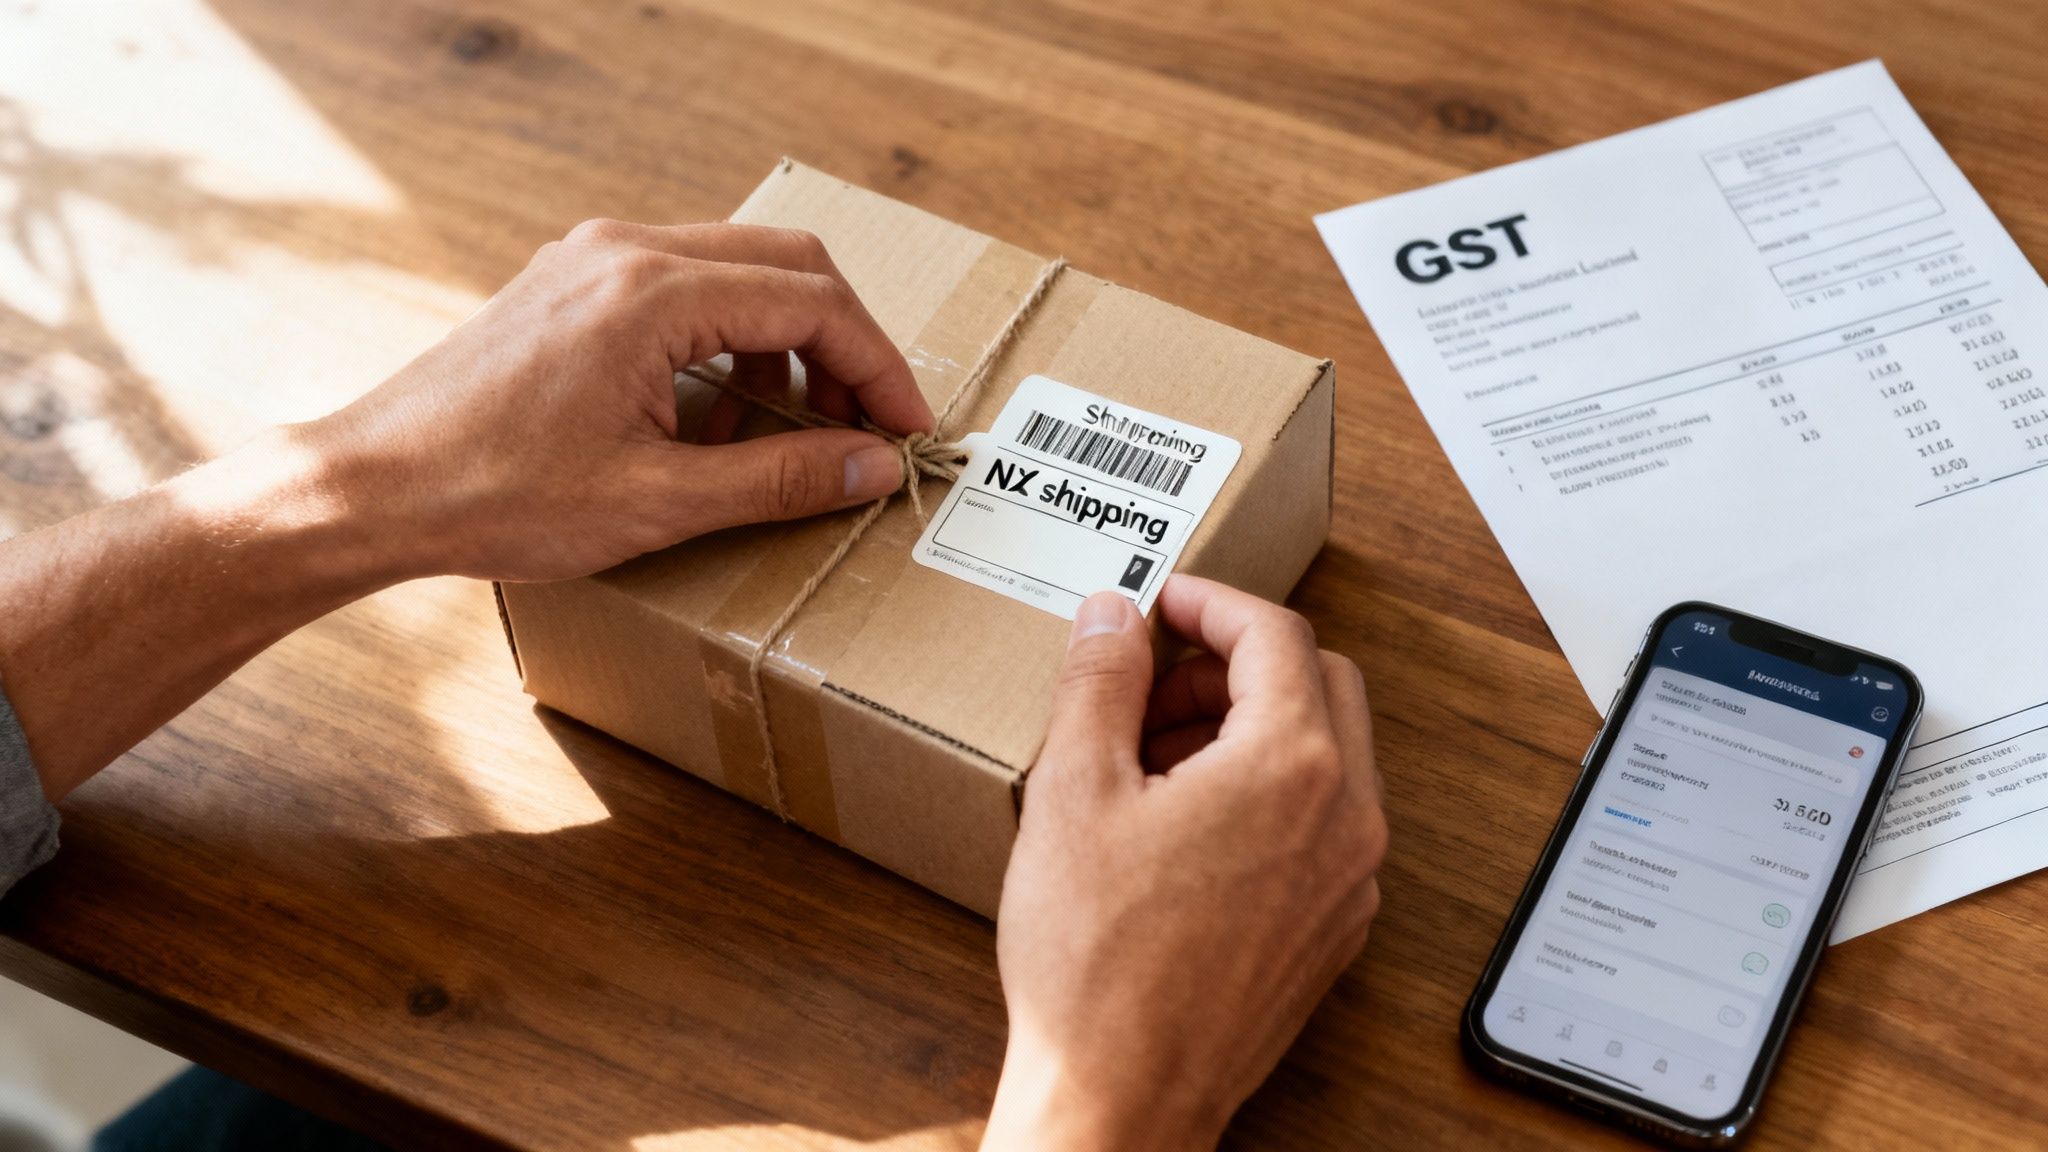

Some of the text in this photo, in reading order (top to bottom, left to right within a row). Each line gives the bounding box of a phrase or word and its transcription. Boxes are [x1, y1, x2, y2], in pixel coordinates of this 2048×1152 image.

[1395, 213, 1529, 284] GST
[984, 458, 1170, 545] NX shipping
